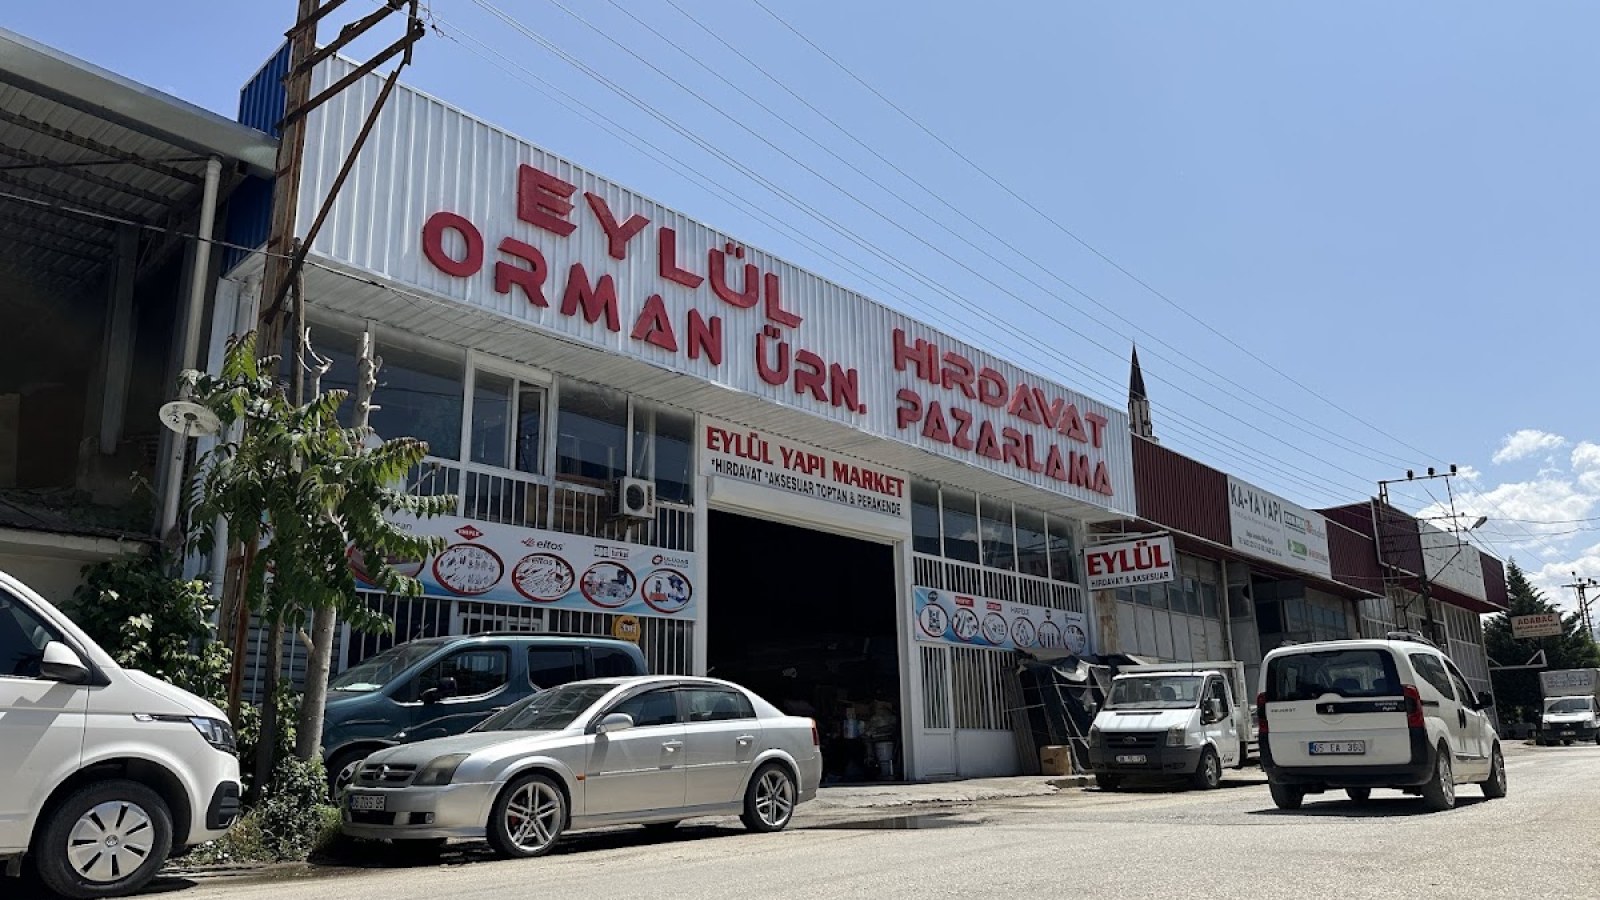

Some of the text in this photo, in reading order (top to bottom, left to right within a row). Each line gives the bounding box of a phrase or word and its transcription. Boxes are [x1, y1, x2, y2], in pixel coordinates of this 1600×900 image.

[518, 163, 803, 329] EYLÜL
[422, 211, 867, 415] ORMAN ÜRN.
[893, 328, 1109, 449] HIRDAVAT
[706, 425, 905, 498] EYLÜL YAPI MARKET
[896, 388, 1114, 497] PAZARLAMA
[815, 482, 848, 502] TOPTAN
[849, 493, 856, 505] &
[857, 494, 901, 515] PERAKENDE
[1087, 540, 1170, 577] EYLÜL
[1132, 571, 1170, 583] AKSESUAR
